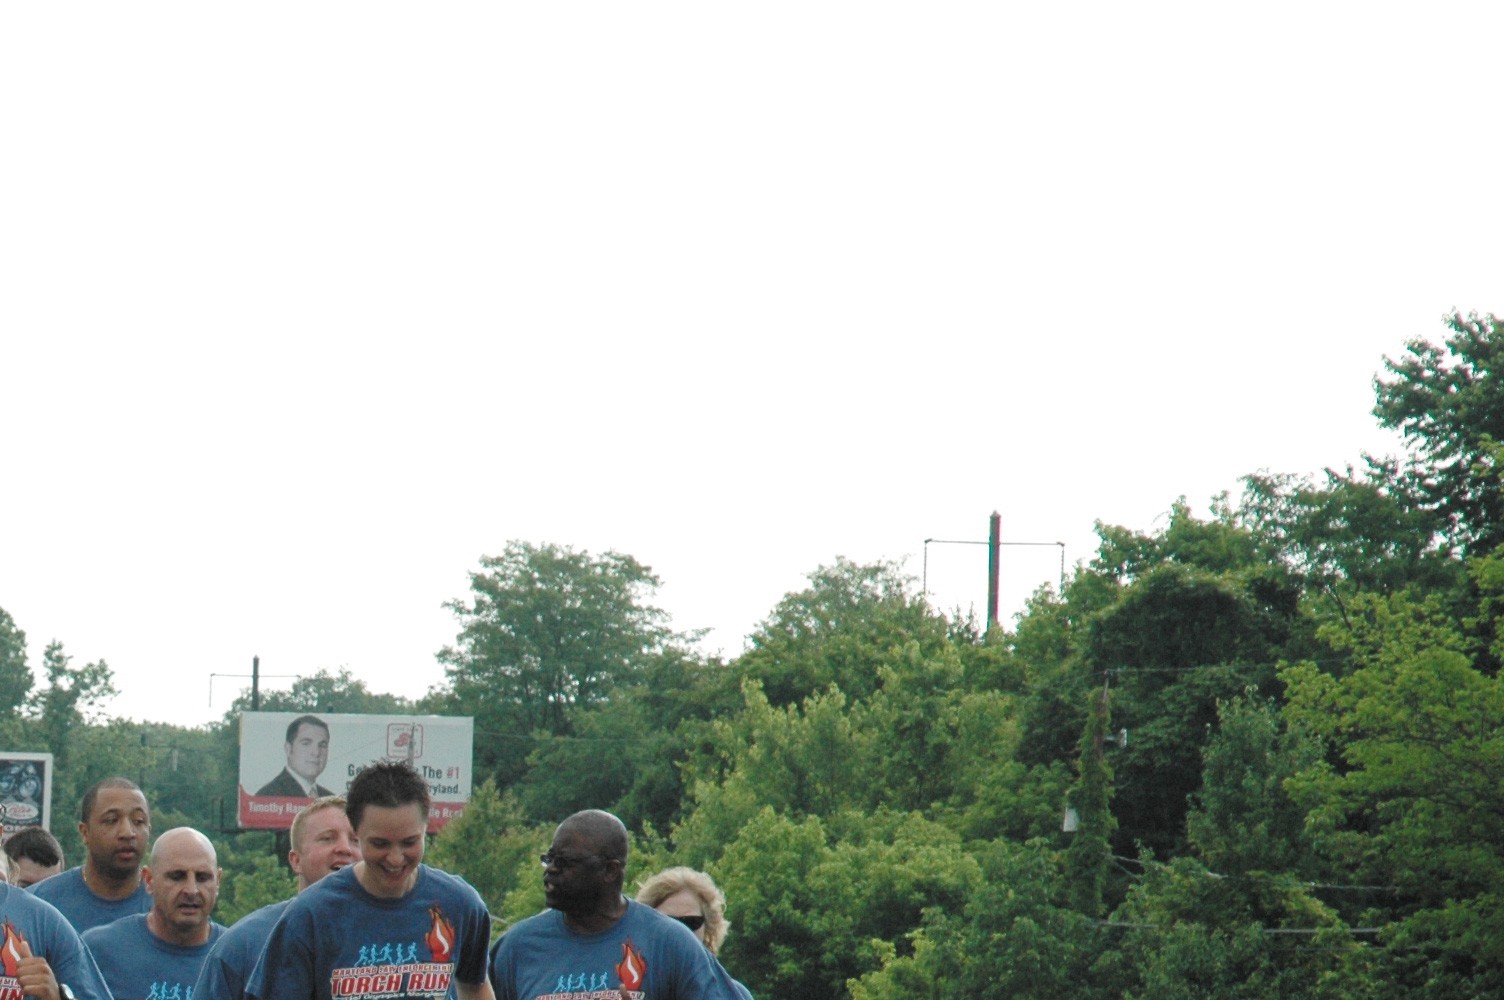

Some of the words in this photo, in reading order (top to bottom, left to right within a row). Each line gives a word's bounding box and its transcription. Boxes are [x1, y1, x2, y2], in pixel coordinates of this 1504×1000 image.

[423, 765, 443, 779] The
[446, 766, 460, 780] #1
[249, 801, 284, 816] Timothy
[332, 967, 378, 978] MARYLAND
[378, 965, 397, 975] LAW
[397, 963, 453, 974] ENFORCEMENT
[330, 973, 402, 996] TORCH
[407, 972, 451, 991] RUN
